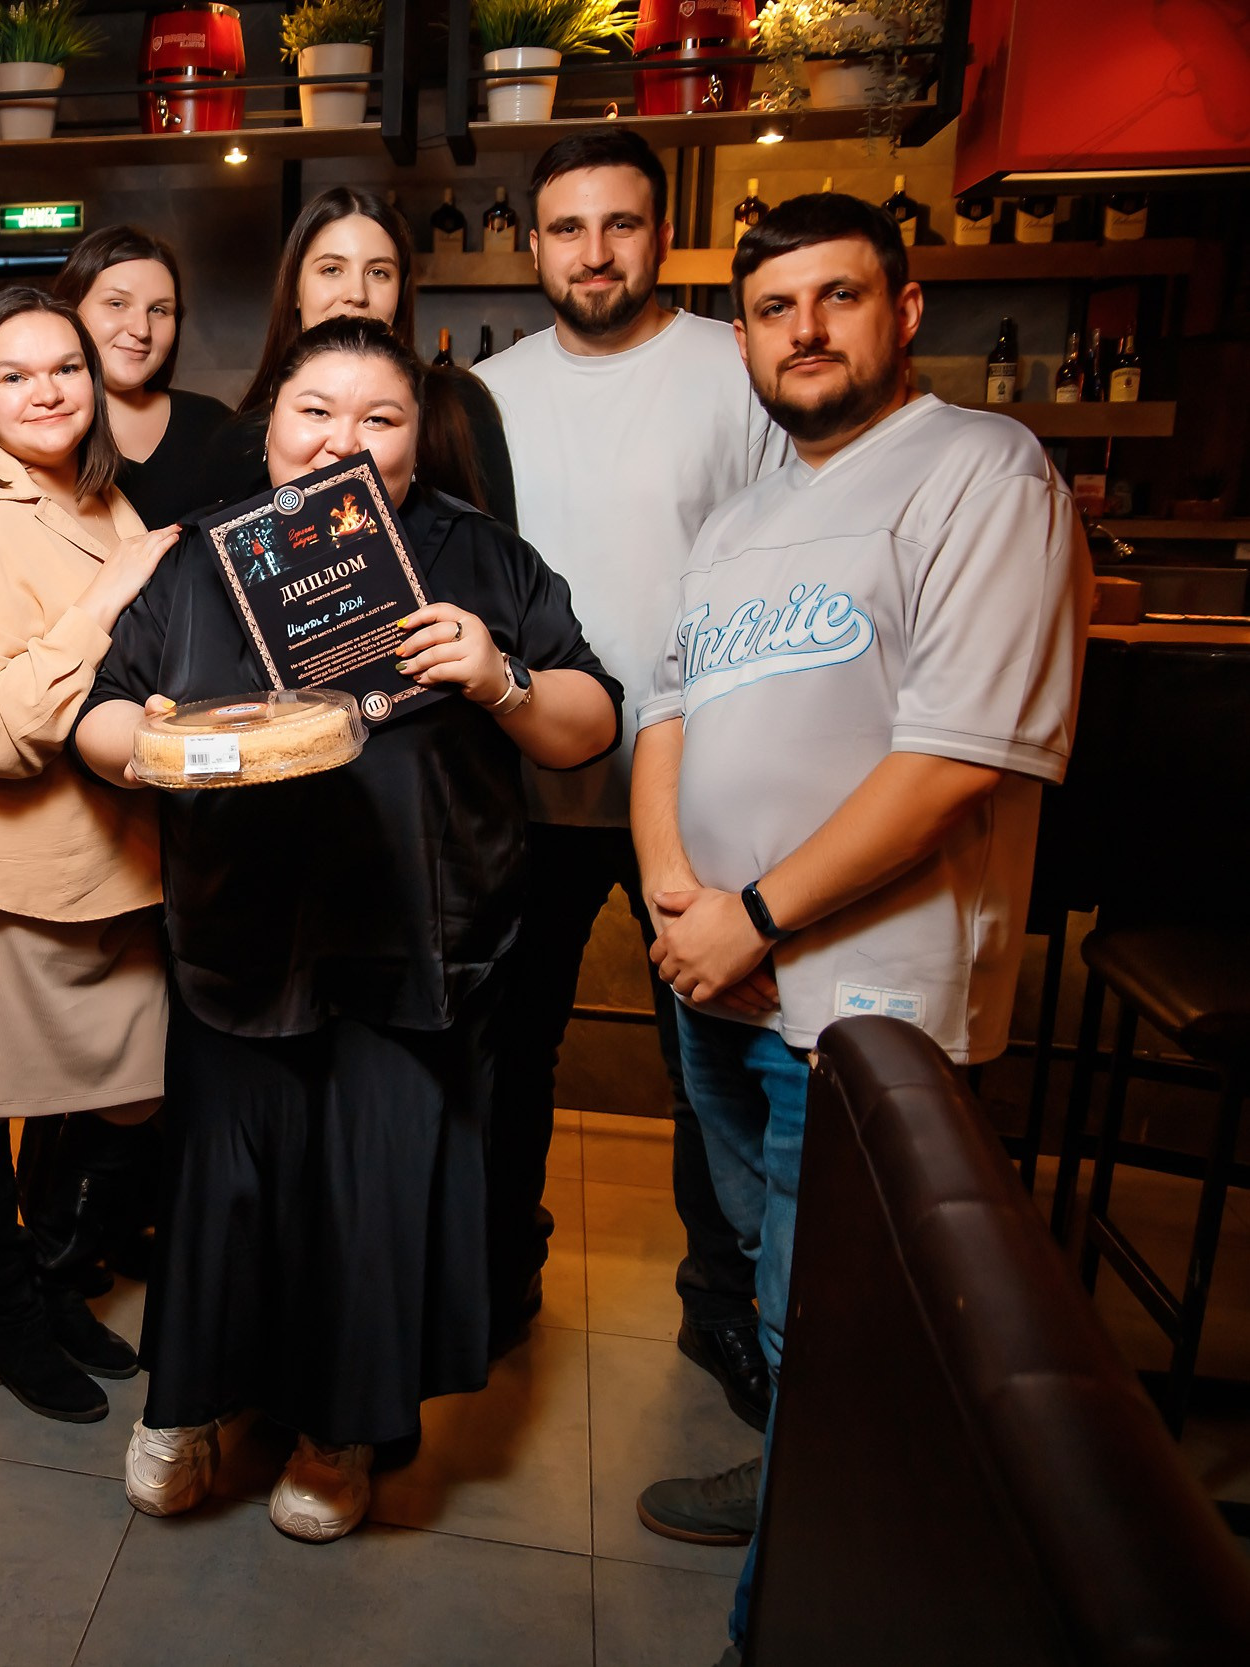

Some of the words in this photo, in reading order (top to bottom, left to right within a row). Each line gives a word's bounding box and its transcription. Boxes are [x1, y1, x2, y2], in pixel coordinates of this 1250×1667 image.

[279, 554, 368, 607] ДИПЛОМ
[331, 583, 351, 595] команде
[317, 629, 332, 638] место
[336, 614, 365, 629] АНТИКВИЗЕ
[677, 583, 852, 682] Infinite
[336, 640, 353, 650] вопрос
[361, 644, 377, 652] Пусть
[368, 698, 385, 712] III
